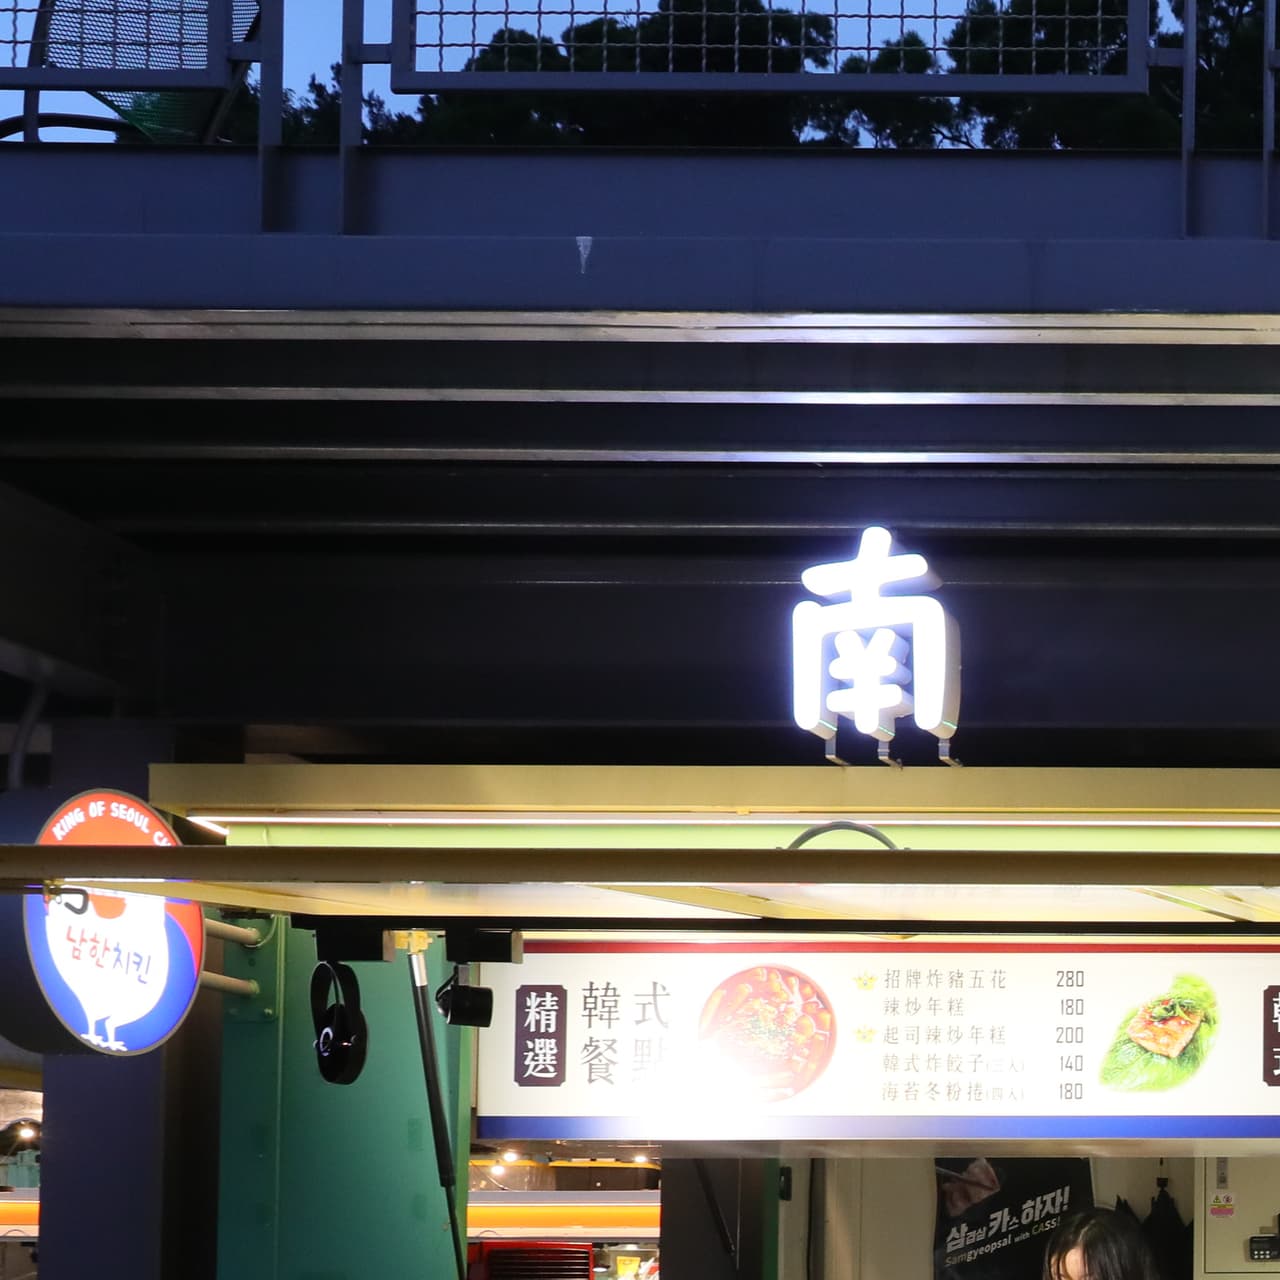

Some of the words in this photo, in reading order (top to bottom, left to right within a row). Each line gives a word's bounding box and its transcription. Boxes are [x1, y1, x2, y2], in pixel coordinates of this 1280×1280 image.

[52, 808, 86, 841] KING
[89, 801, 106, 818] OF
[110, 802, 150, 834] SEOUL
[66, 925, 152, 985] 남한치킨
[884, 969, 1007, 989] 招牌炸豬五花
[1056, 970, 1085, 988] 280
[581, 981, 671, 1029] 韓式
[883, 997, 965, 1017] 辣炒年糕
[1060, 999, 1084, 1015] 180
[524, 991, 560, 1078] 精選
[882, 1025, 1006, 1046] 起司辣炒年糕
[1055, 1027, 1084, 1043] 200
[1060, 1055, 1083, 1072] 140
[1059, 1083, 1083, 1100] 180
